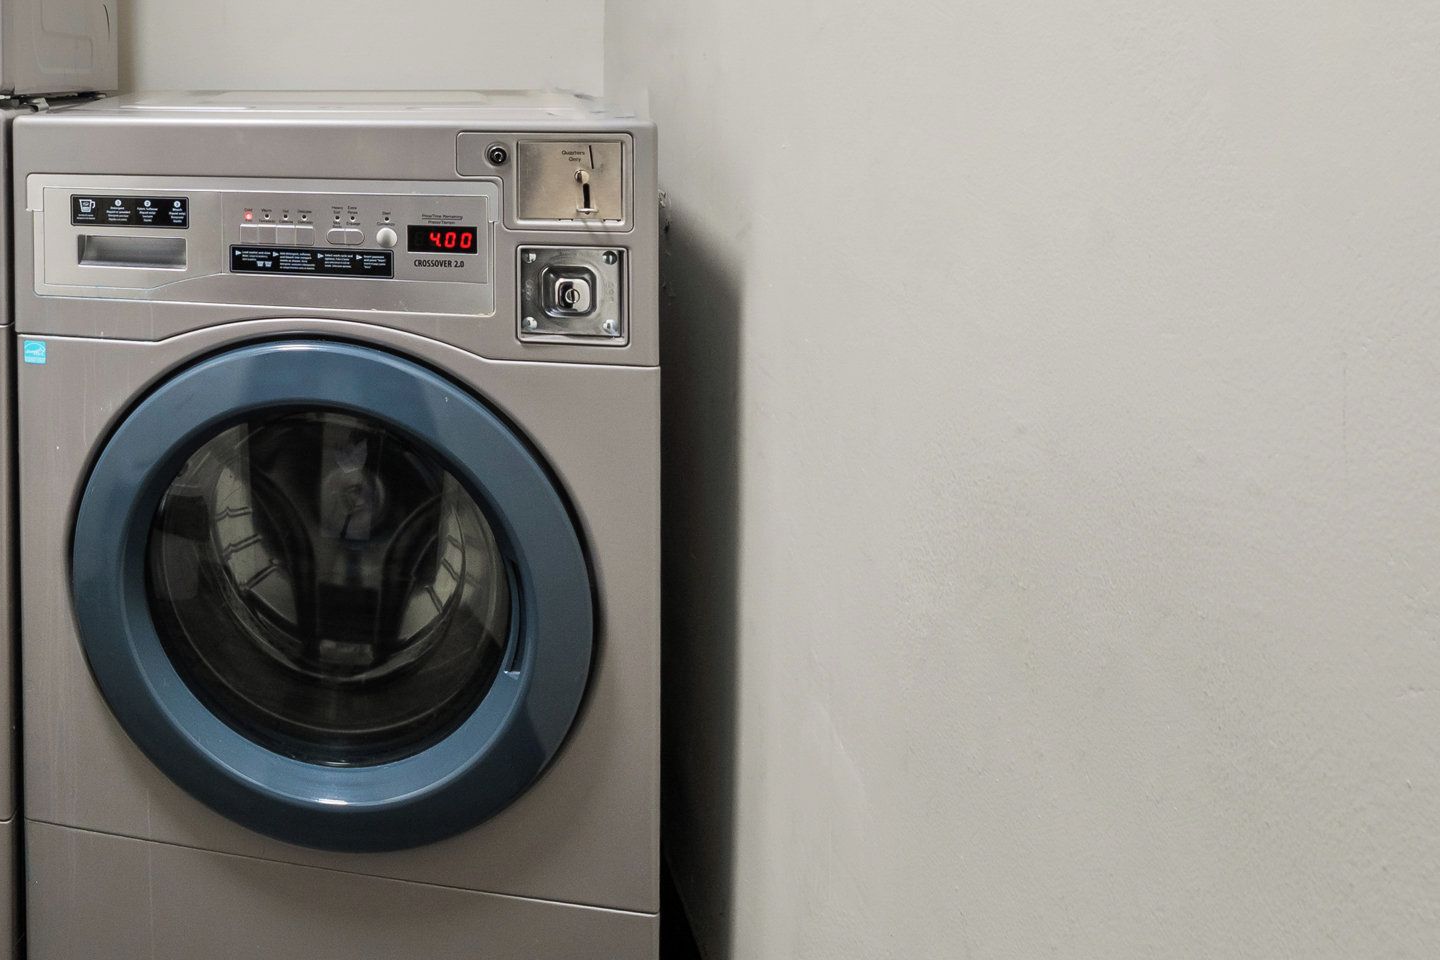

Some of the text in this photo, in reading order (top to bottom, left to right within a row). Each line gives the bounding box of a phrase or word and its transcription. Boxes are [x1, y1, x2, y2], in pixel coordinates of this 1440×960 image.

[429, 231, 473, 249] 4.00
[414, 259, 465, 268] CROSSOVER 2.0
